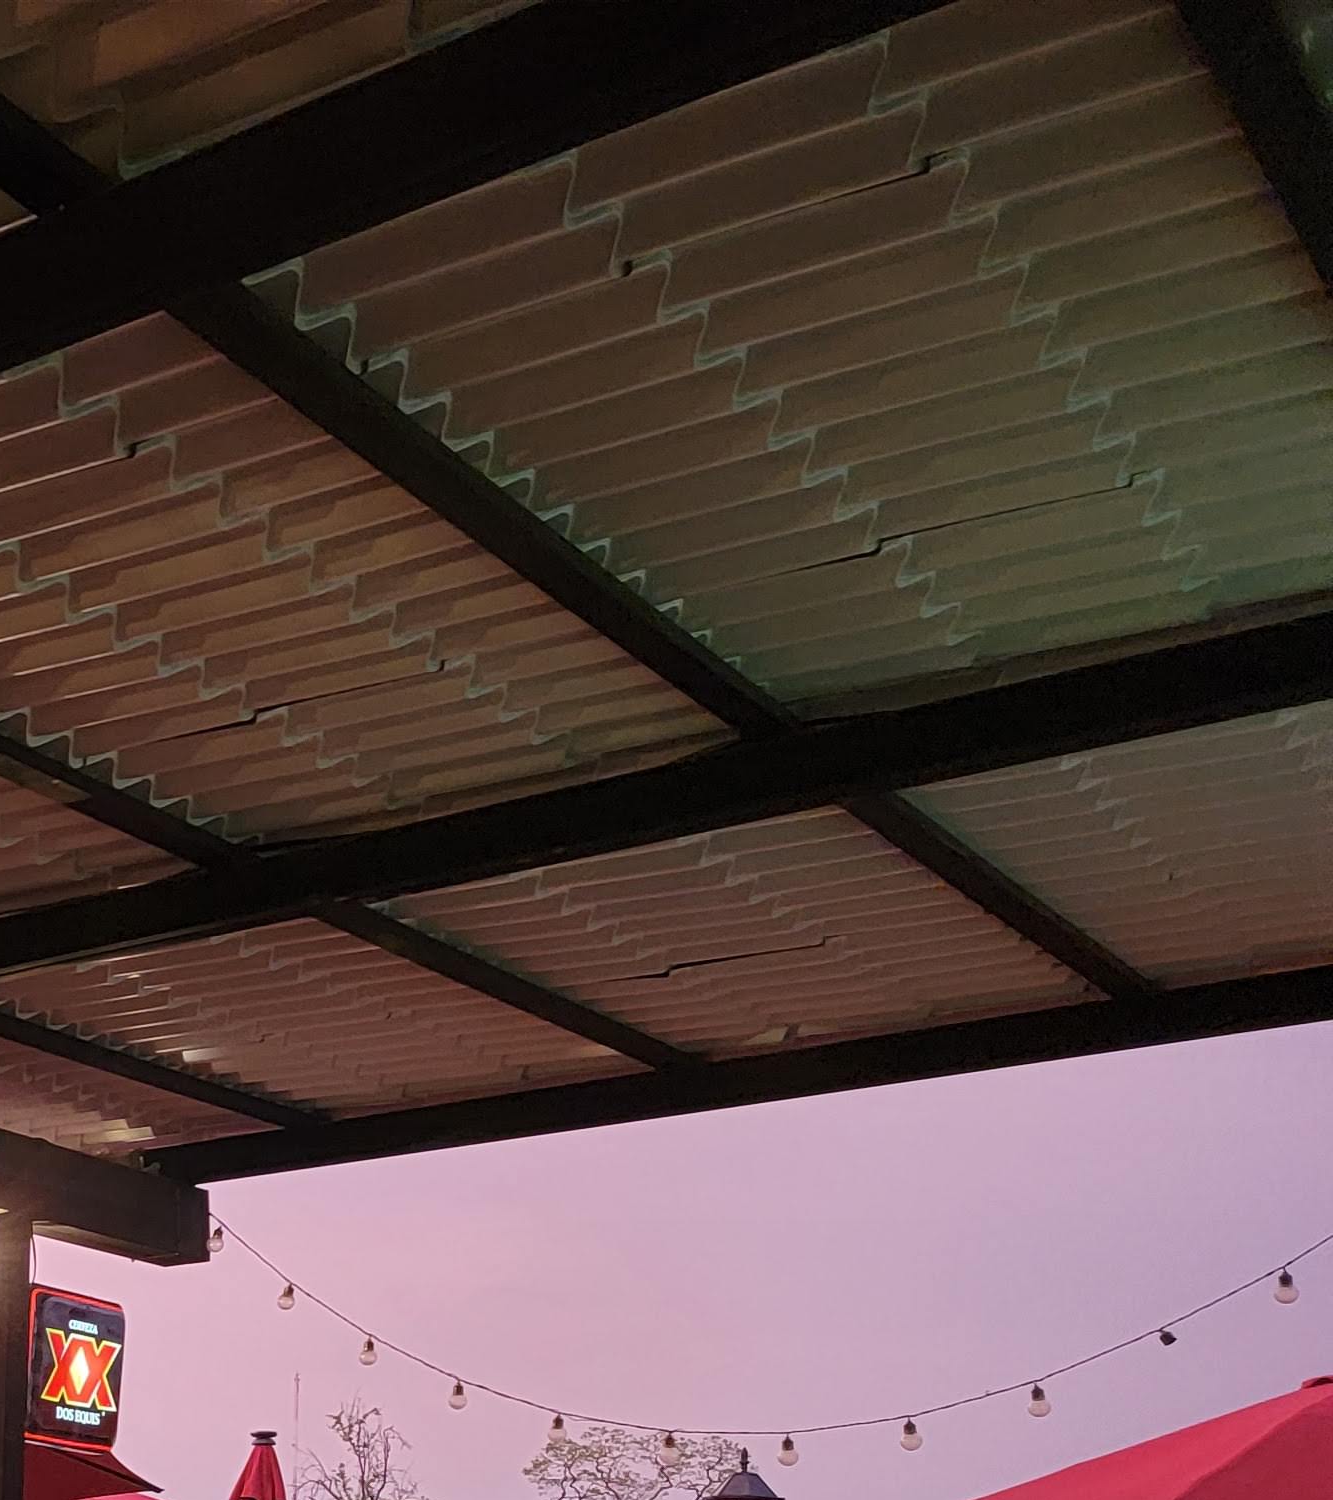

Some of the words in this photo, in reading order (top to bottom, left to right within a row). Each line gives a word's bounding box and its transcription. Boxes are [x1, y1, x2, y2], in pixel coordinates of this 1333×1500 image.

[41, 1327, 121, 1411] XX
[56, 1406, 74, 1421] DOS
[74, 1409, 100, 1425] EQUIS
